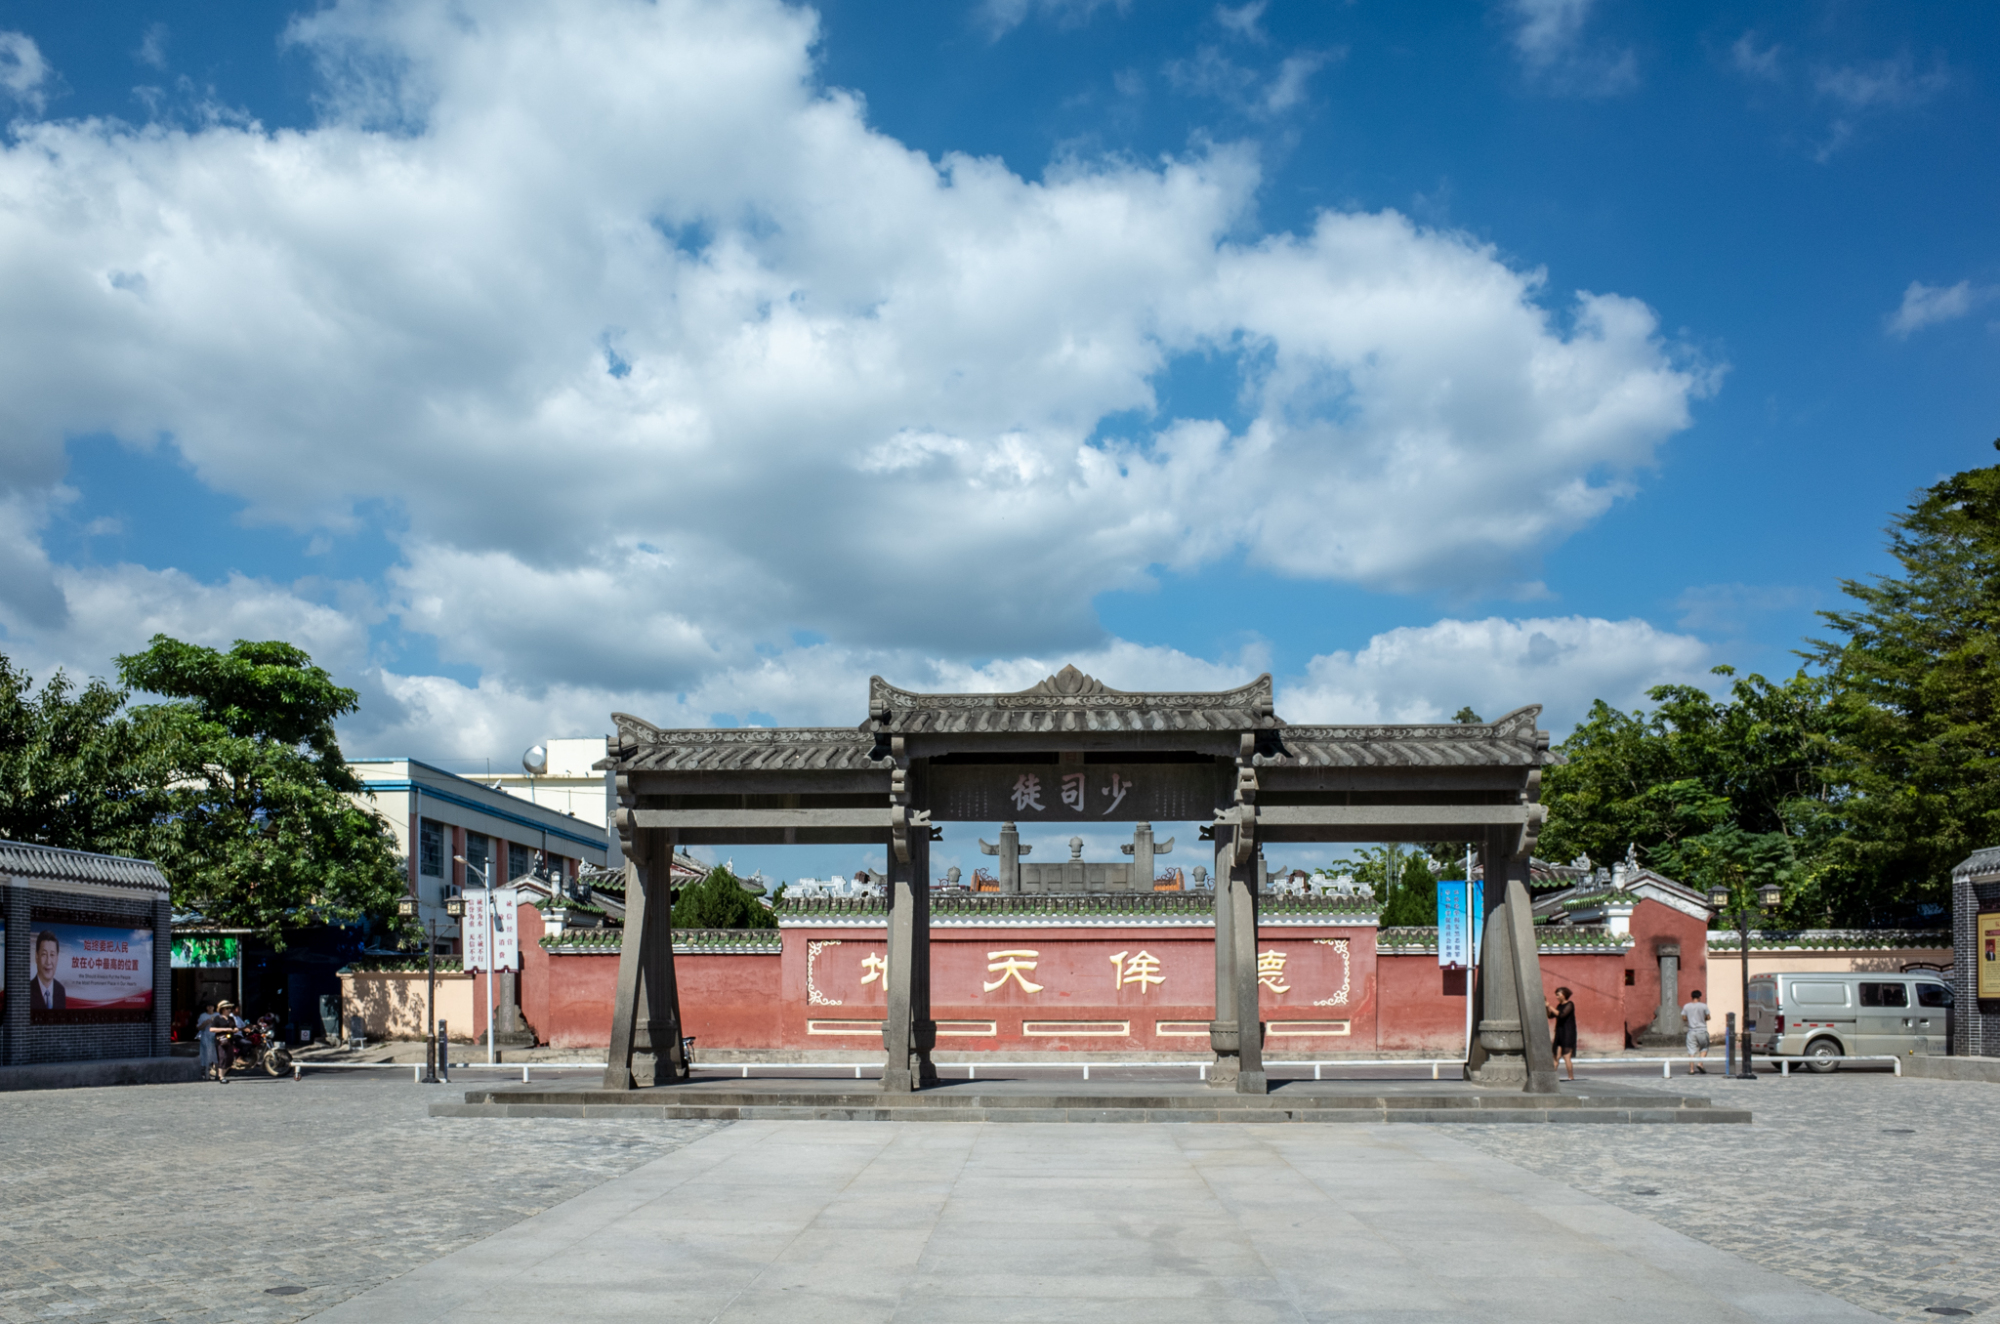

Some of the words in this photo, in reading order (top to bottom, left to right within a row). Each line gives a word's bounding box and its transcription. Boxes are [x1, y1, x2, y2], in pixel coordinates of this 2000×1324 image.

[84, 940, 128, 953] 始终要把人民
[72, 957, 138, 971] 放在心中最高的位置
